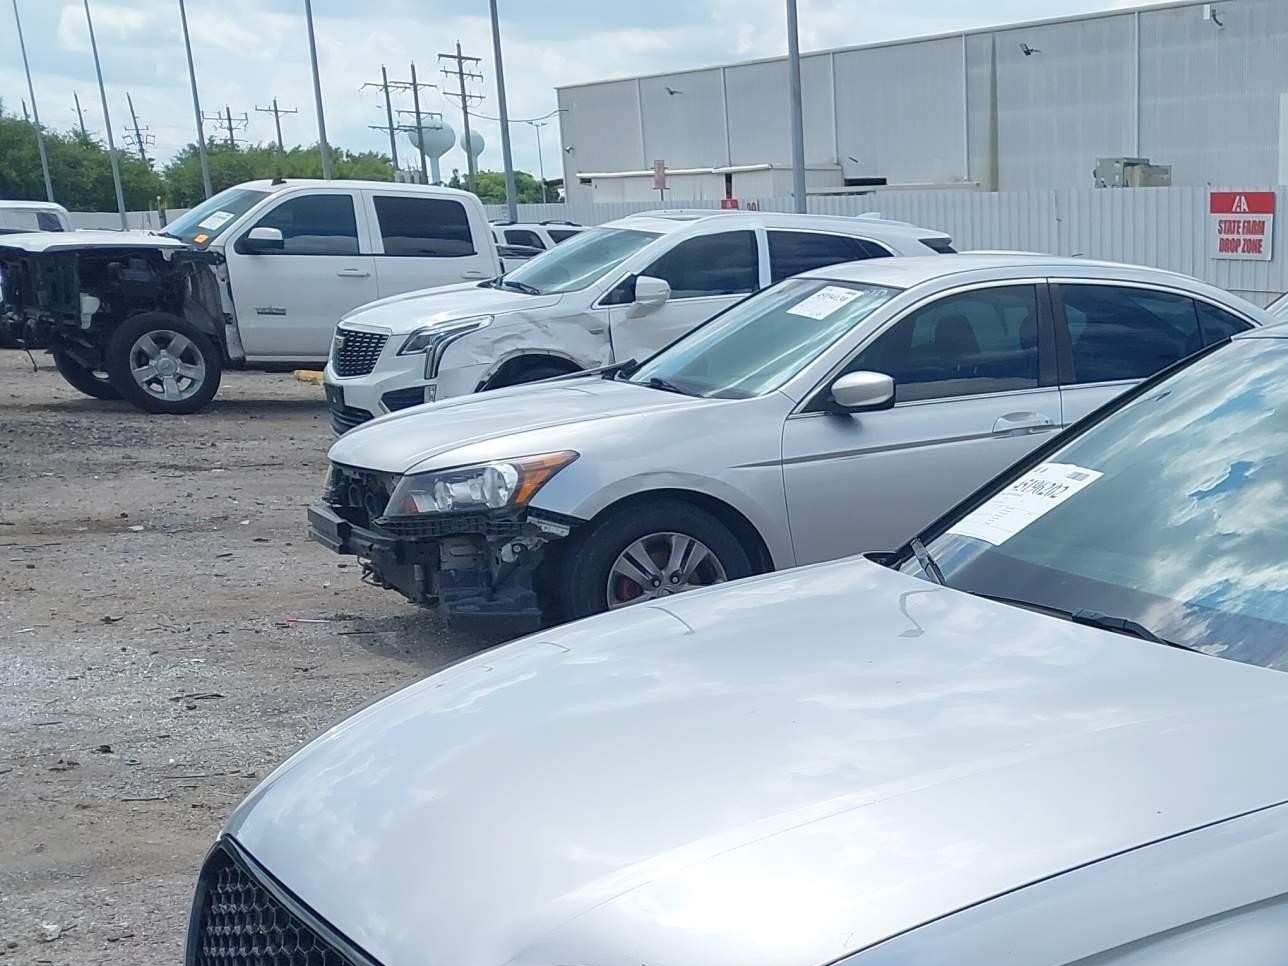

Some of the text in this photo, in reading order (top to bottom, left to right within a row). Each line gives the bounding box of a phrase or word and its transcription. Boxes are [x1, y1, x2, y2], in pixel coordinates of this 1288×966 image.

[1217, 219, 1265, 235] STATE FARM
[1219, 238, 1263, 254] DROP ZONE
